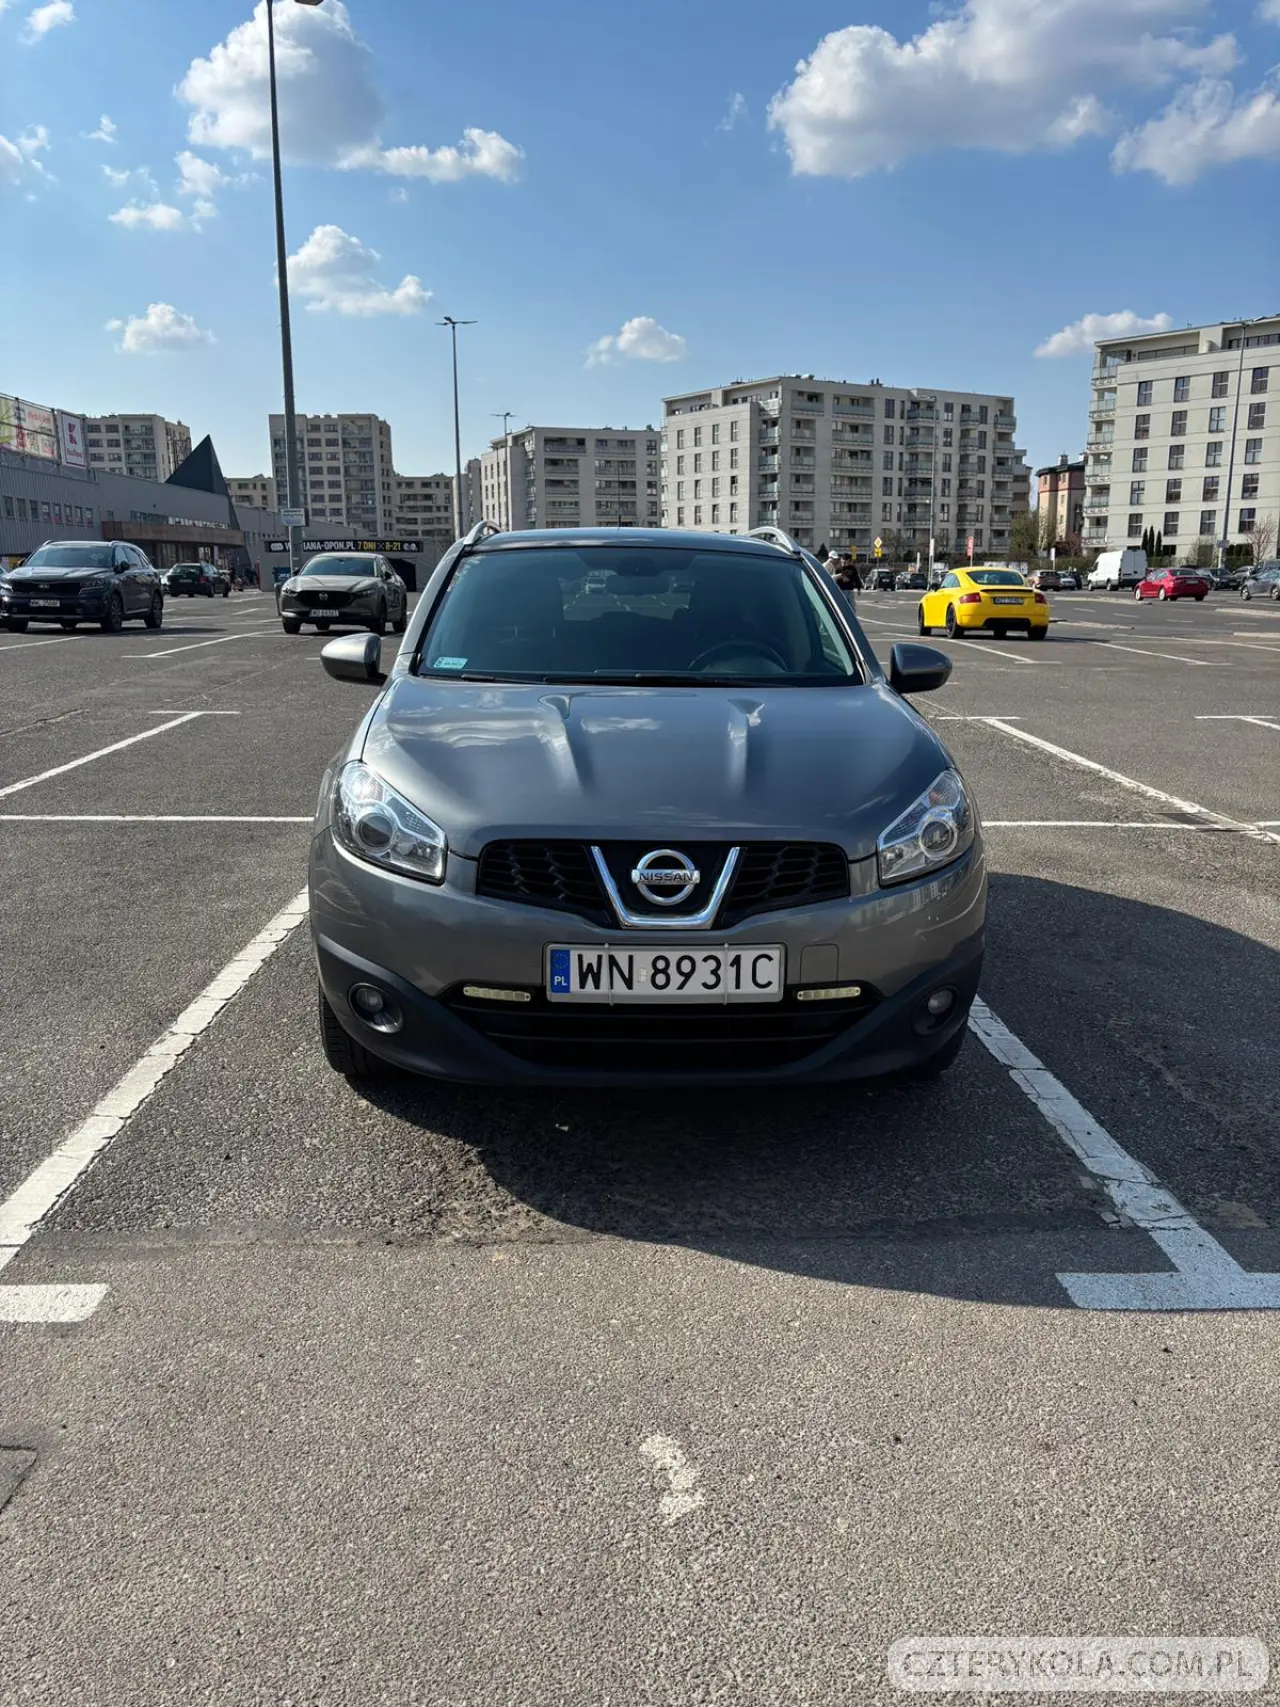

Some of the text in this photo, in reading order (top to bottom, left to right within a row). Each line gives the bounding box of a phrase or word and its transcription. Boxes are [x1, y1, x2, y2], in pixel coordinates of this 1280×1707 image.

[363, 541, 376, 550] DNI
[640, 872, 693, 881] NISSAN
[577, 953, 774, 990] WN 8931C
[554, 976, 568, 986] PL
